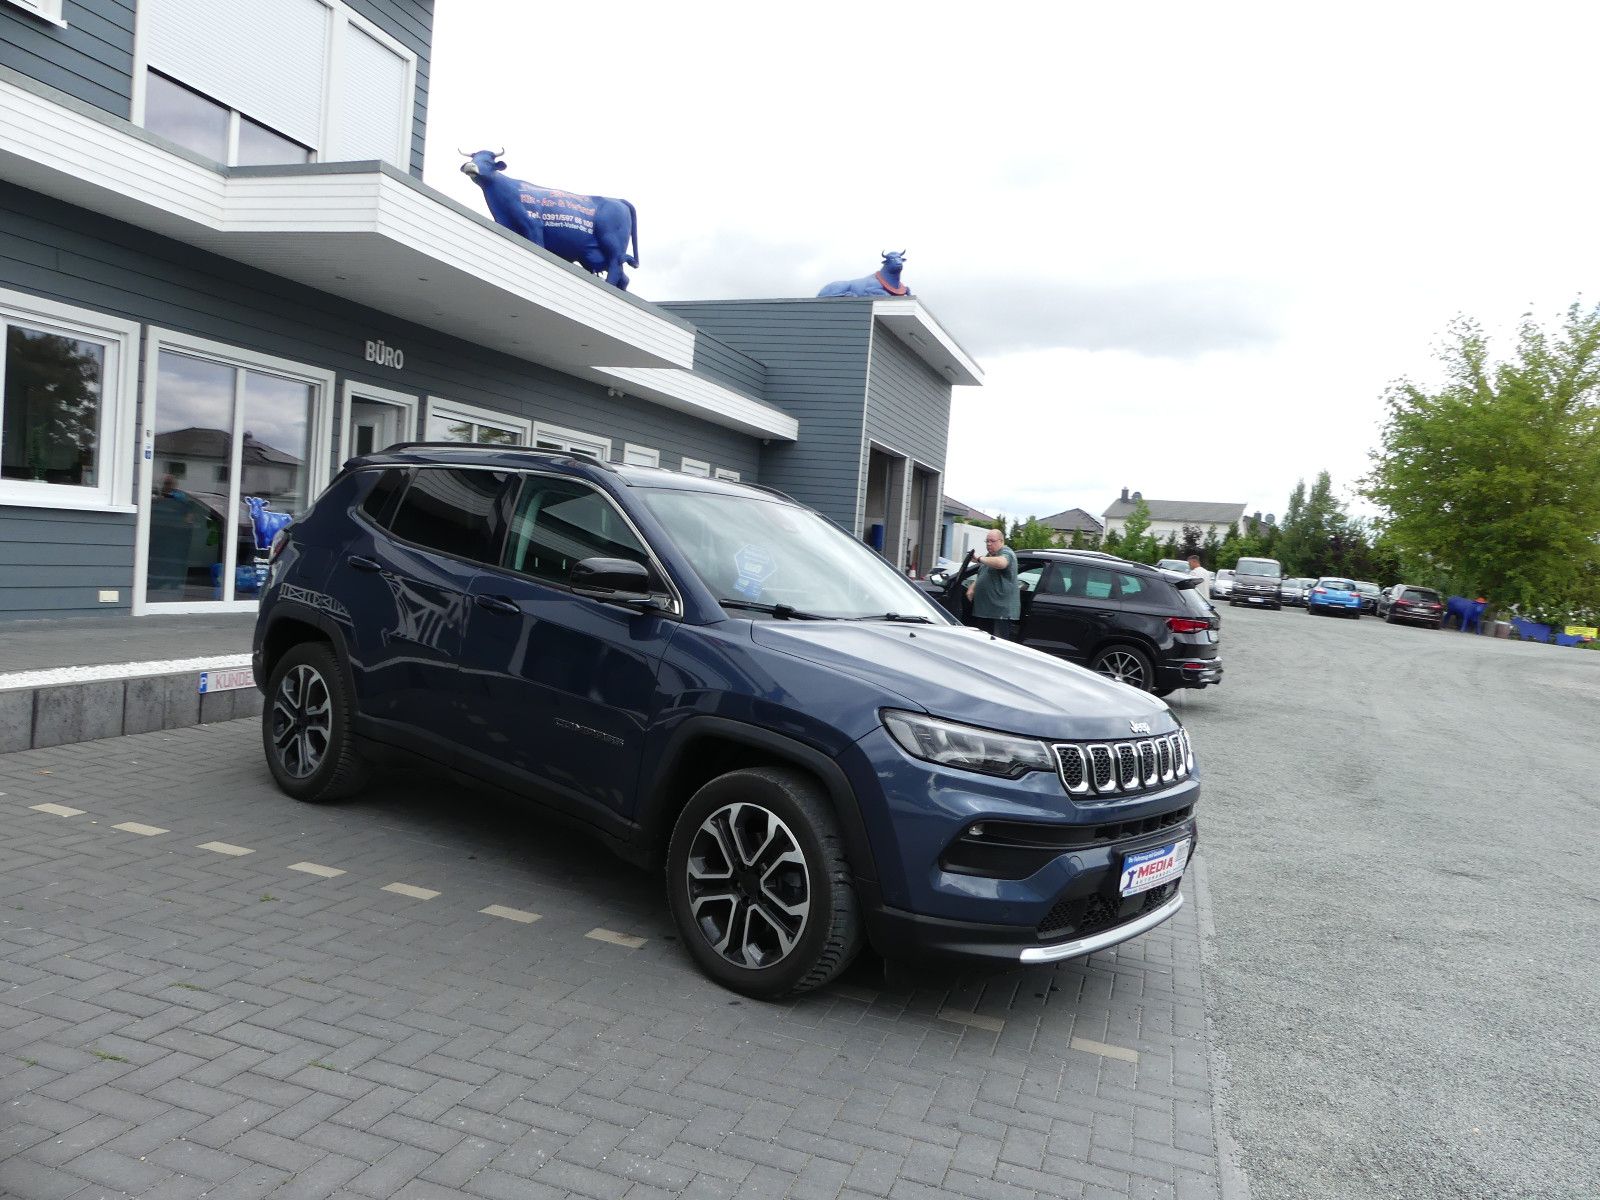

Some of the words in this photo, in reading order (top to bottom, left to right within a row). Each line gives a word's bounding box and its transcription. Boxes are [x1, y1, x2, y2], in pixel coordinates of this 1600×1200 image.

[528, 211, 541, 219] Tel.
[365, 339, 404, 370] BÜRO
[1137, 857, 1174, 879] MEDIA
